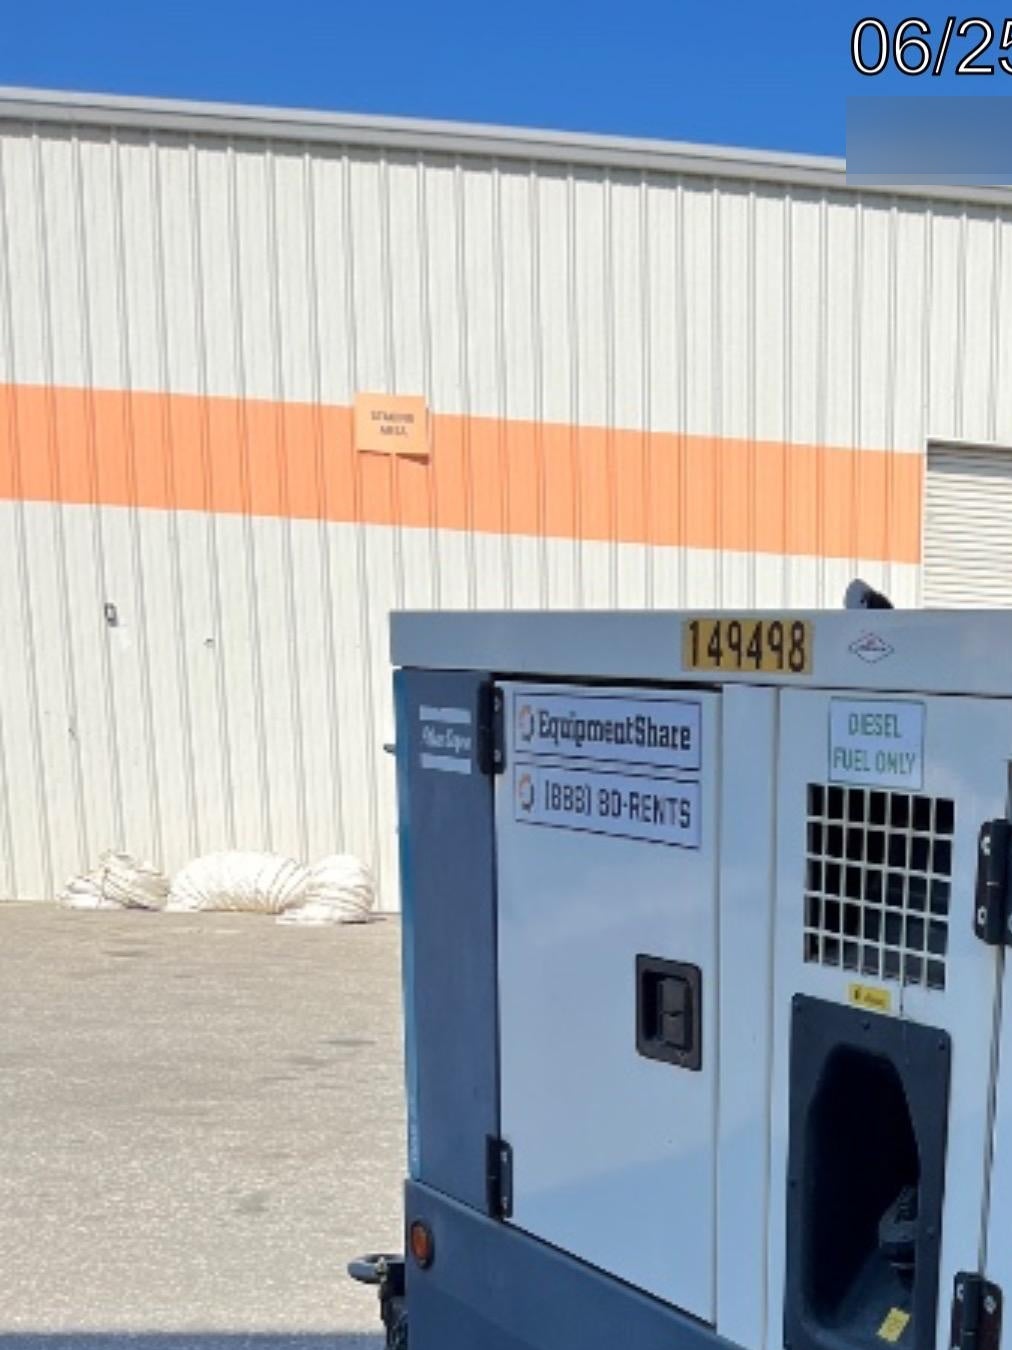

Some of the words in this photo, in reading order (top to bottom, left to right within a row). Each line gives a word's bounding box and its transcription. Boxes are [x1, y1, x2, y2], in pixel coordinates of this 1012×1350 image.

[688, 619, 806, 673] 149498
[538, 709, 691, 751] EquipmentShare
[848, 712, 902, 739] DIESEL
[832, 746, 871, 773] FUEL
[875, 750, 916, 776] ONLY
[544, 779, 592, 817] (888)
[599, 788, 691, 829] 80-RENTS
